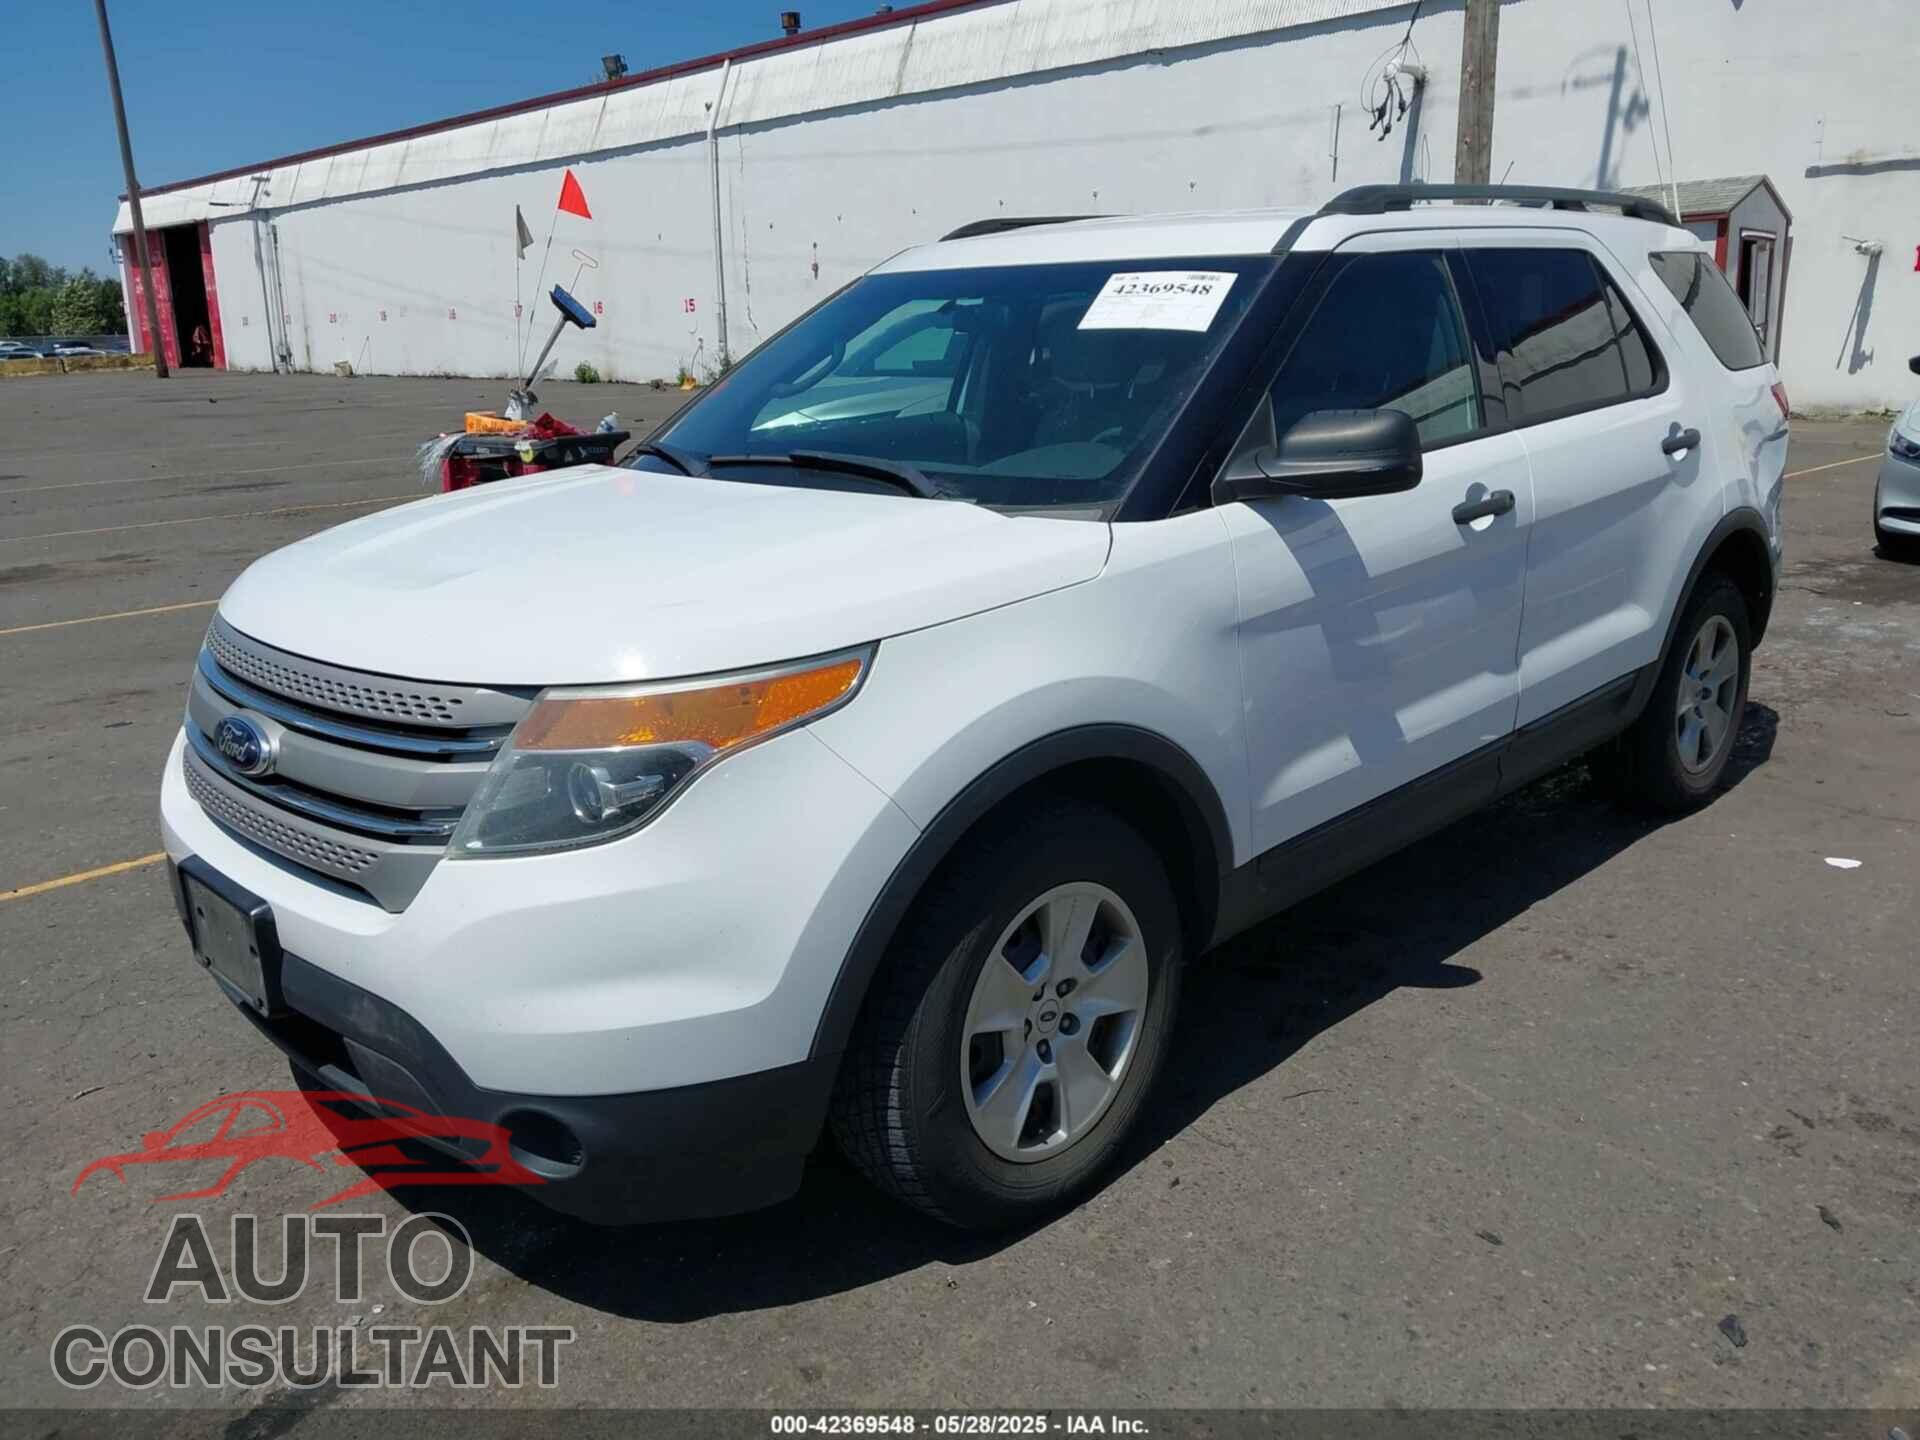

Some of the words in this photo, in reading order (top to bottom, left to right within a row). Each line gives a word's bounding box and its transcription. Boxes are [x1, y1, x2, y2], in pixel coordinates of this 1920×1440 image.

[1112, 283, 1214, 296] 42369548
[593, 301, 603, 314] 16
[684, 298, 696, 313] 15
[219, 724, 249, 762] Ford
